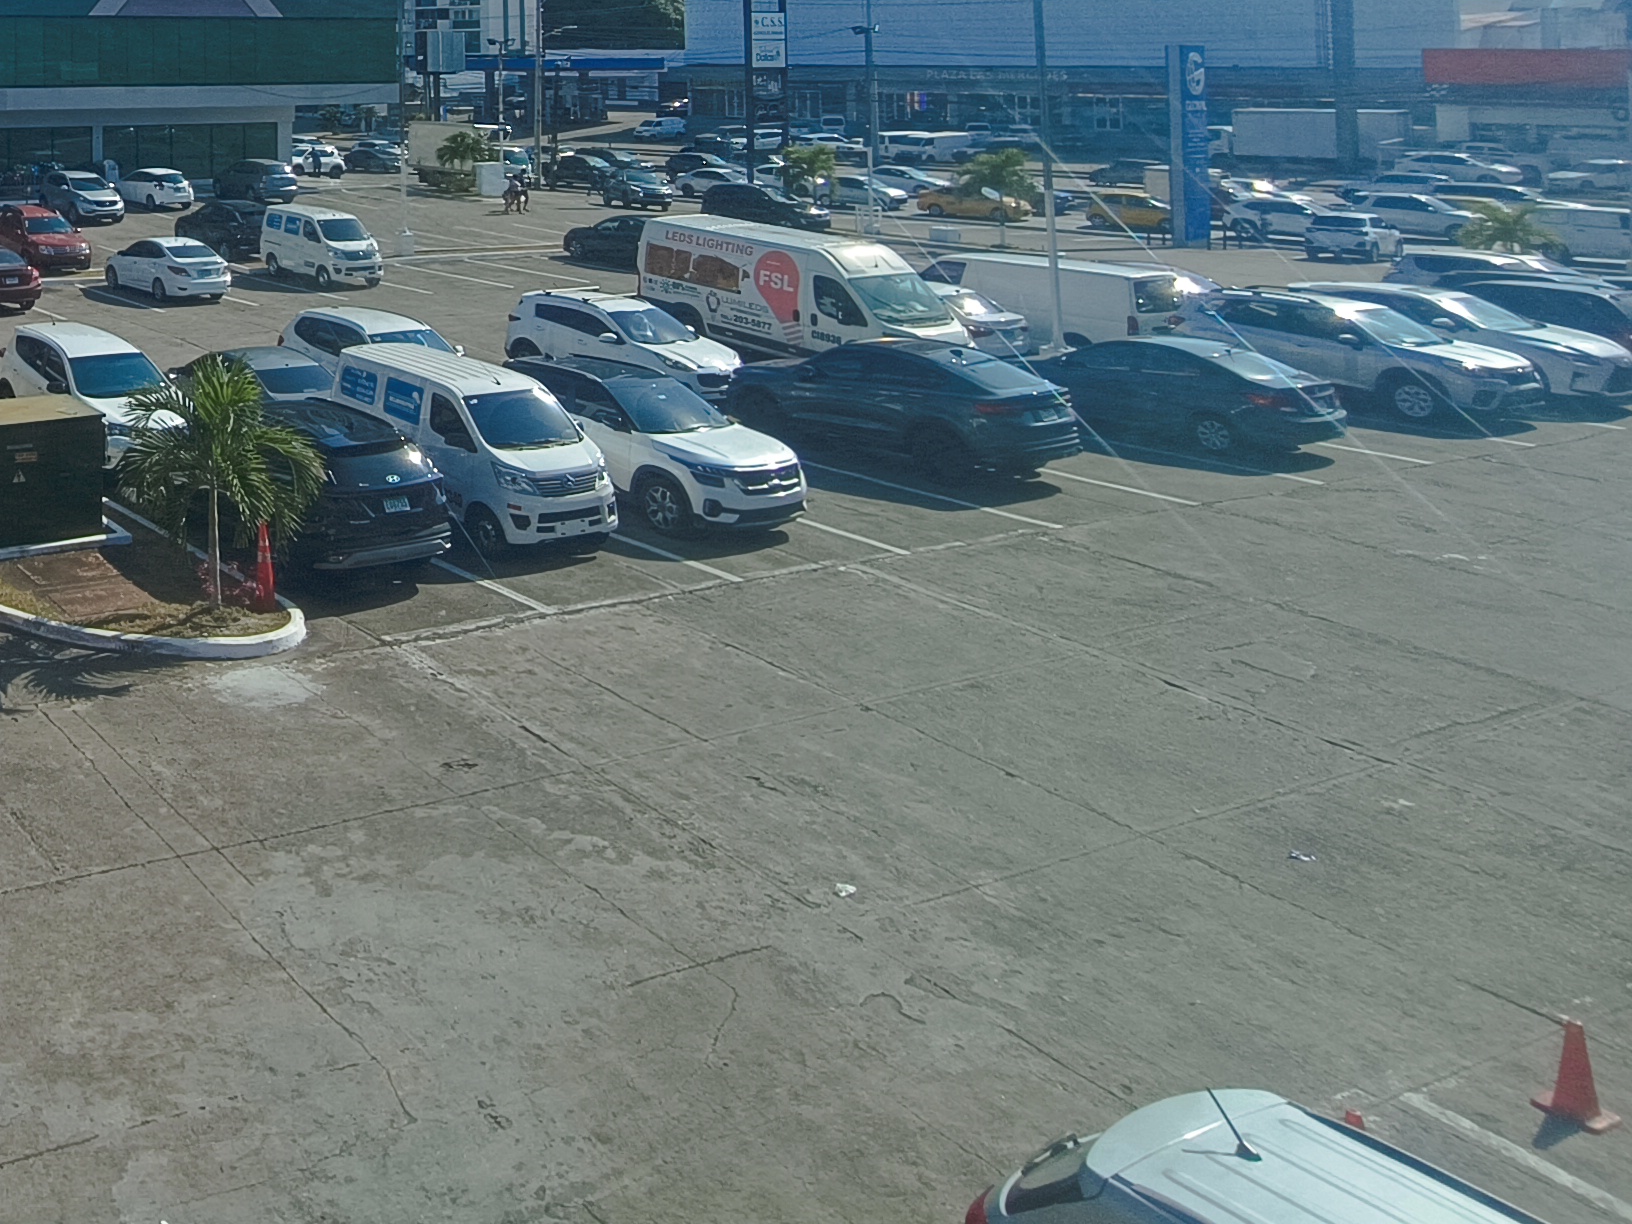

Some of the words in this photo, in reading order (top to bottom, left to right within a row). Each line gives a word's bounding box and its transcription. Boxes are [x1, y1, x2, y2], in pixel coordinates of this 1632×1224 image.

[665, 230, 694, 245] LEDS
[696, 236, 754, 256] LIGHTING
[759, 269, 795, 292] FSL
[720, 296, 770, 314] LUMILEDS
